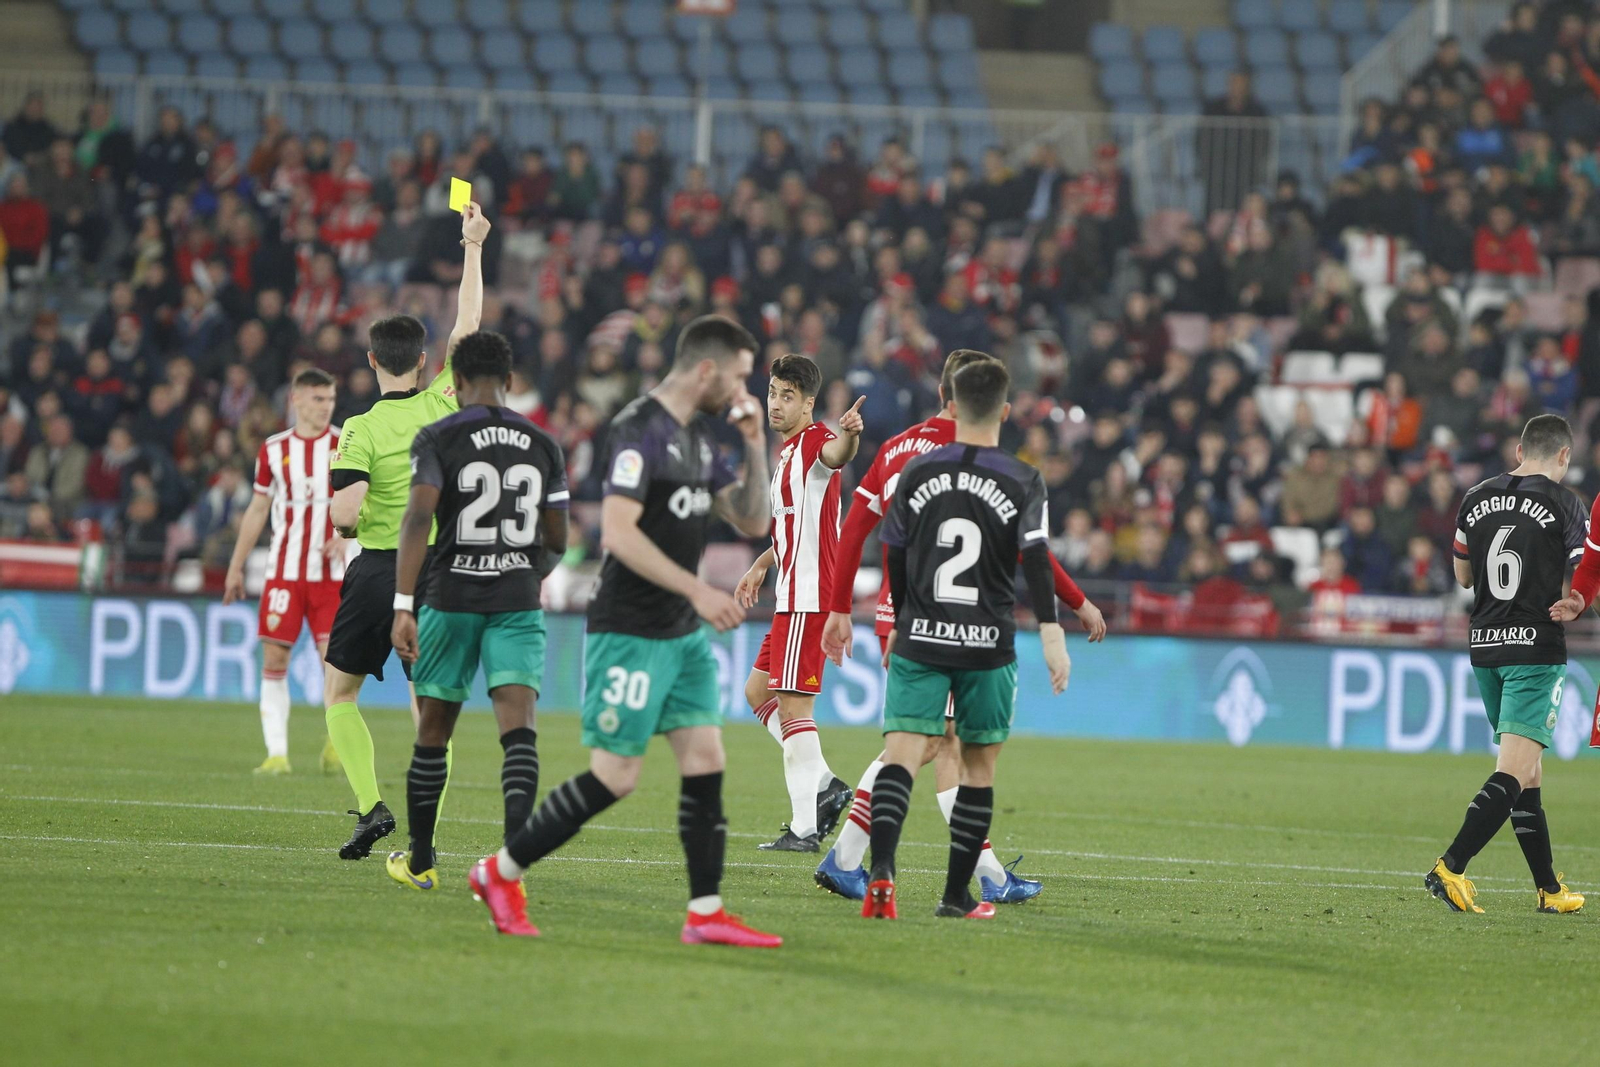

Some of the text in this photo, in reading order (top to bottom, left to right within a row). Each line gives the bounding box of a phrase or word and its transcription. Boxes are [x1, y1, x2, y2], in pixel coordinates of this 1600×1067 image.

[470, 426, 532, 451] KITOKO
[884, 437, 915, 467] JUAN
[456, 461, 543, 548] 23
[908, 473, 953, 515] AITOR
[957, 471, 1019, 526] BUÑUEL
[1466, 495, 1556, 529] SERGIO RUIZ
[452, 554, 477, 570] EL
[933, 517, 982, 606] 2
[1486, 525, 1523, 601] 6
[268, 587, 291, 614] 18
[911, 618, 933, 636] EL
[935, 621, 1000, 642] DIARIO
[1471, 626, 1537, 643] EL DIARIO
[91, 600, 257, 700] PDR
[603, 665, 650, 711] 30
[1551, 676, 1564, 707] 6
